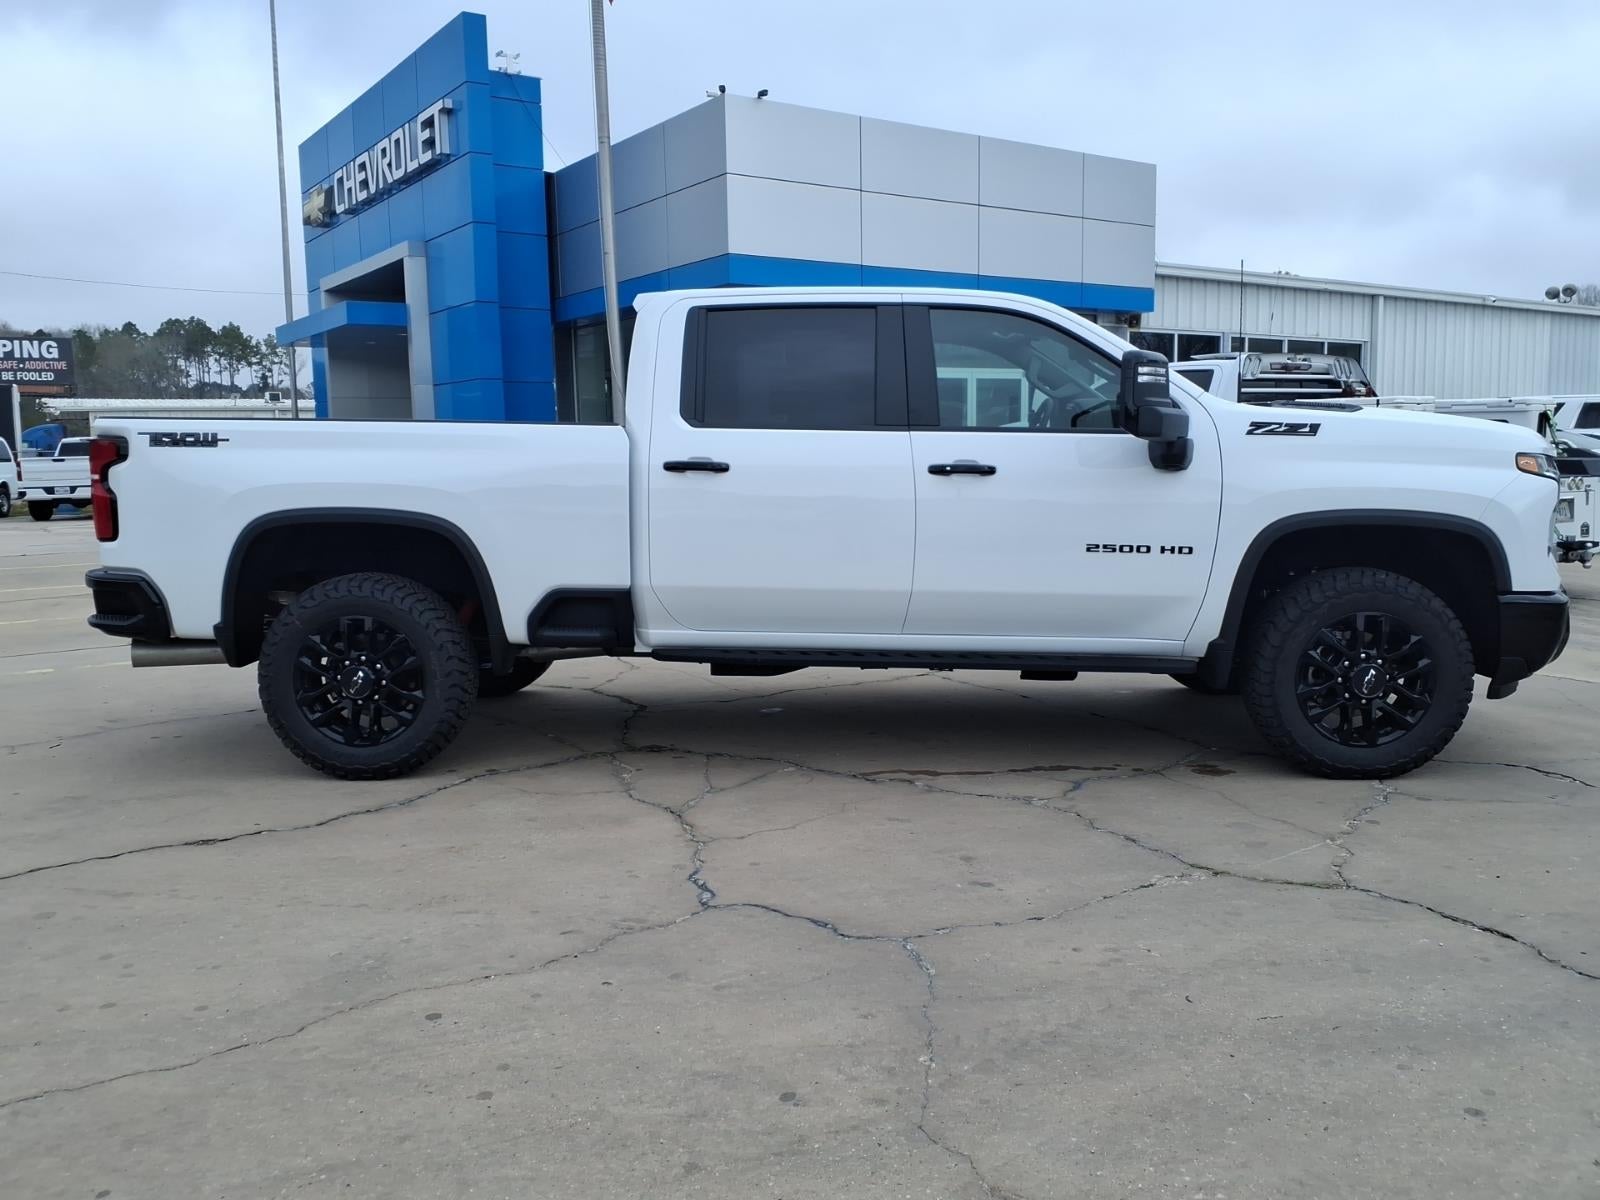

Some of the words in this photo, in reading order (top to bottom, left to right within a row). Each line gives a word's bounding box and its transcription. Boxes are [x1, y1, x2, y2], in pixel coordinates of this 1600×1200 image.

[333, 98, 453, 214] CHEVROLET
[0, 340, 59, 359] PING
[25, 361, 68, 370] ADDICTIVE
[1, 372, 15, 380] BE
[17, 372, 55, 381] FOOLED
[1086, 544, 1151, 553] 2500
[1160, 546, 1193, 554] HD
